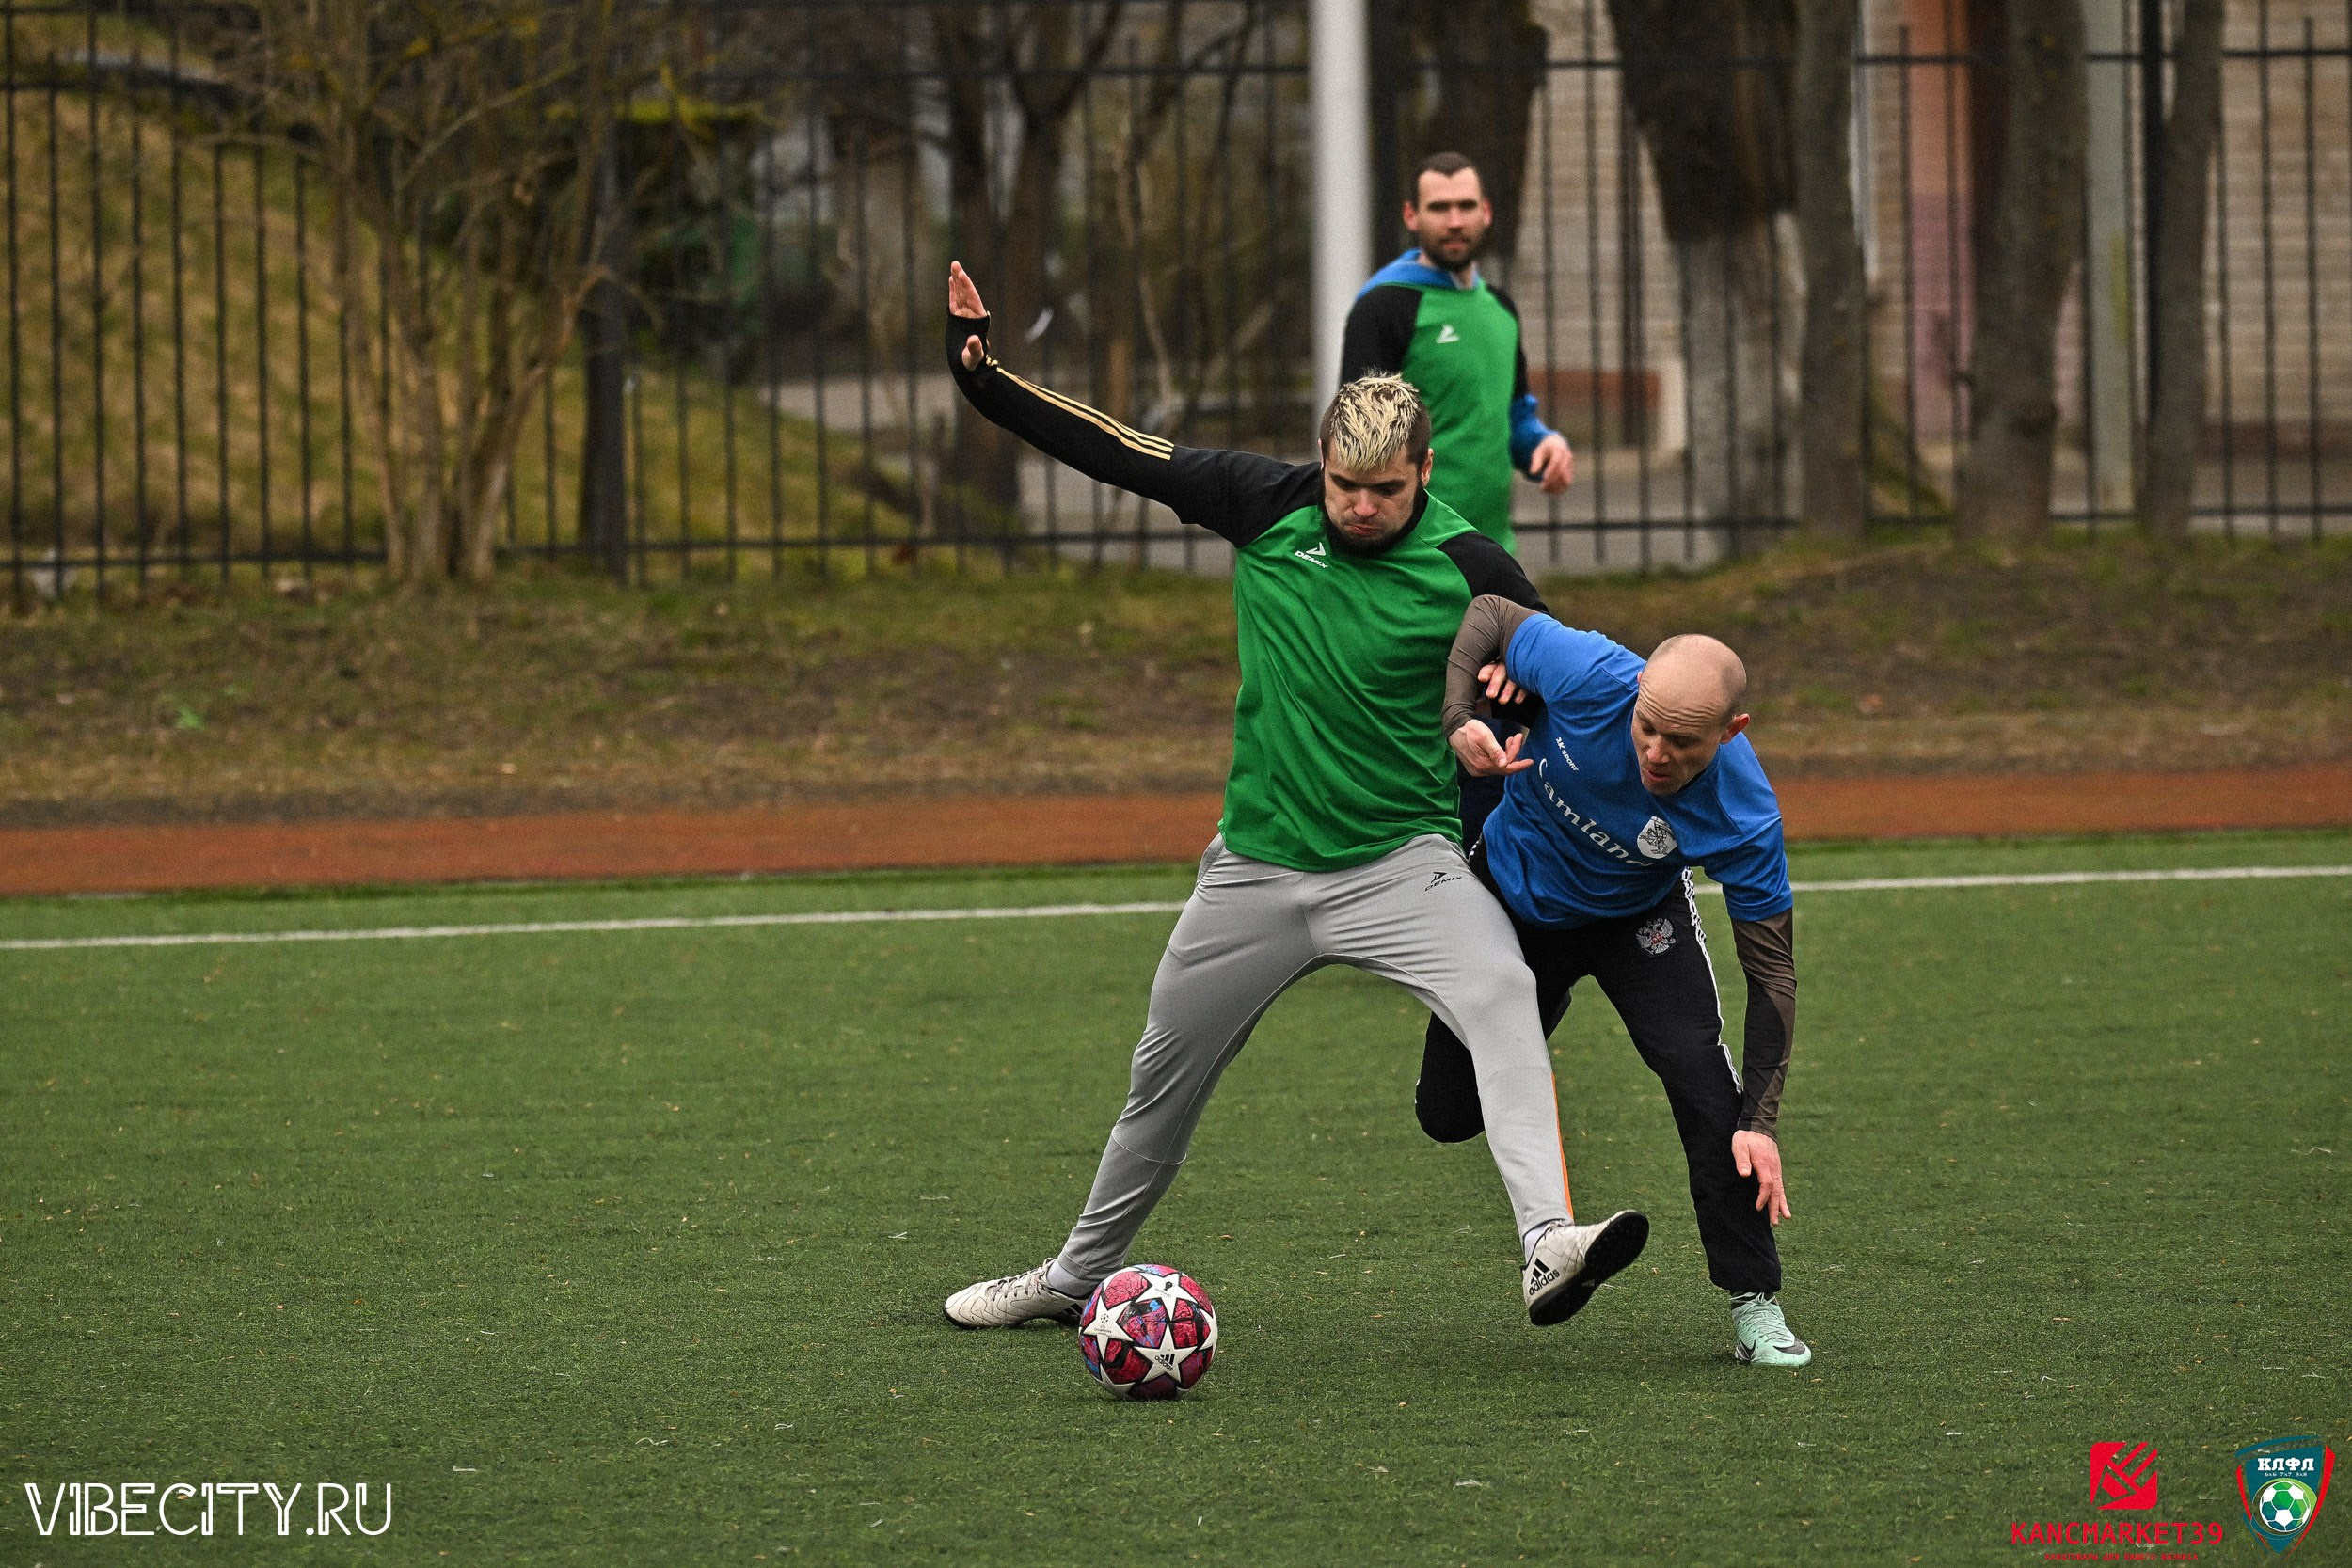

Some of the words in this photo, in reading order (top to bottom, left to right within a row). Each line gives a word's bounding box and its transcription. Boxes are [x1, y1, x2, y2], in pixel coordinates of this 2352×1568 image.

[1555, 736, 1565, 750] 2K
[1561, 749, 1580, 771] SPORT
[1528, 1268, 1561, 1296] adidas
[1154, 1354, 1174, 1372] adidas
